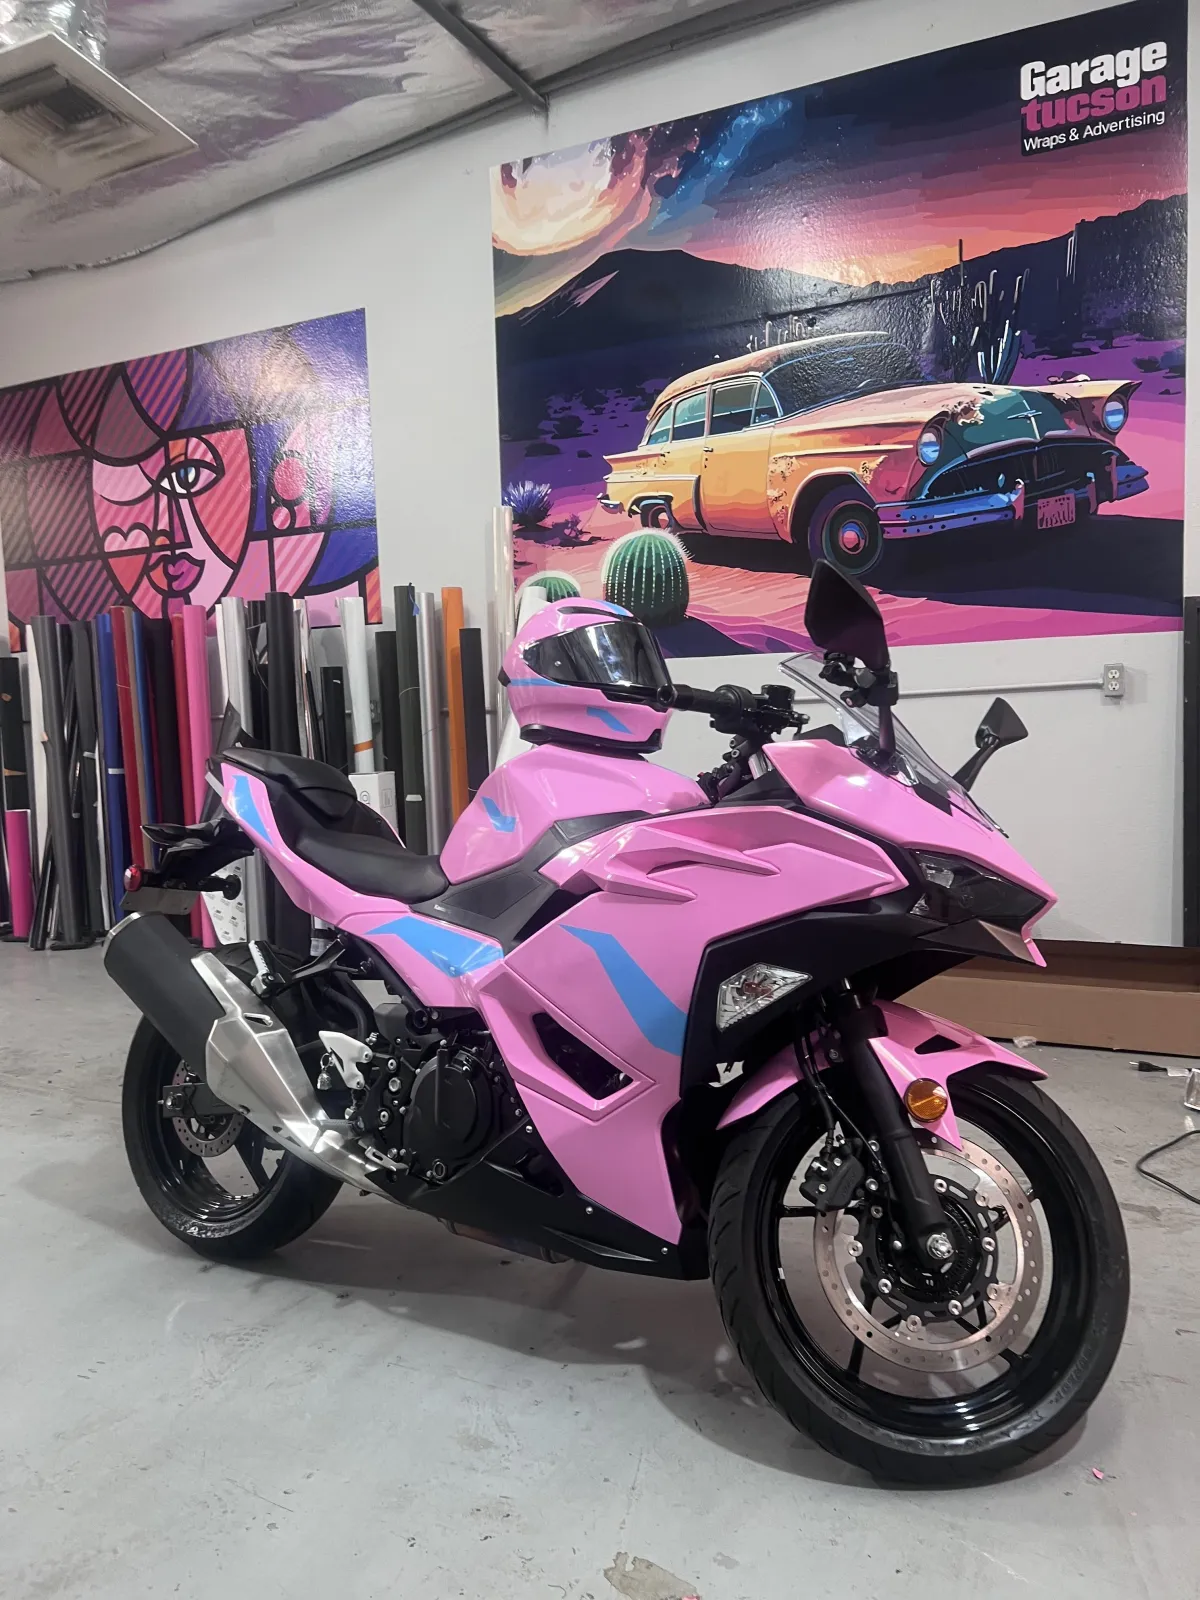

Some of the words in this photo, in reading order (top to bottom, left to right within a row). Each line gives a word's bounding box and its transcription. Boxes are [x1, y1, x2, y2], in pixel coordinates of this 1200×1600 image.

[1020, 41, 1167, 101] Garage
[1020, 75, 1167, 132] tucson
[1023, 133, 1066, 151] Wraps
[1069, 128, 1080, 141] &
[1083, 111, 1165, 138] Advertising
